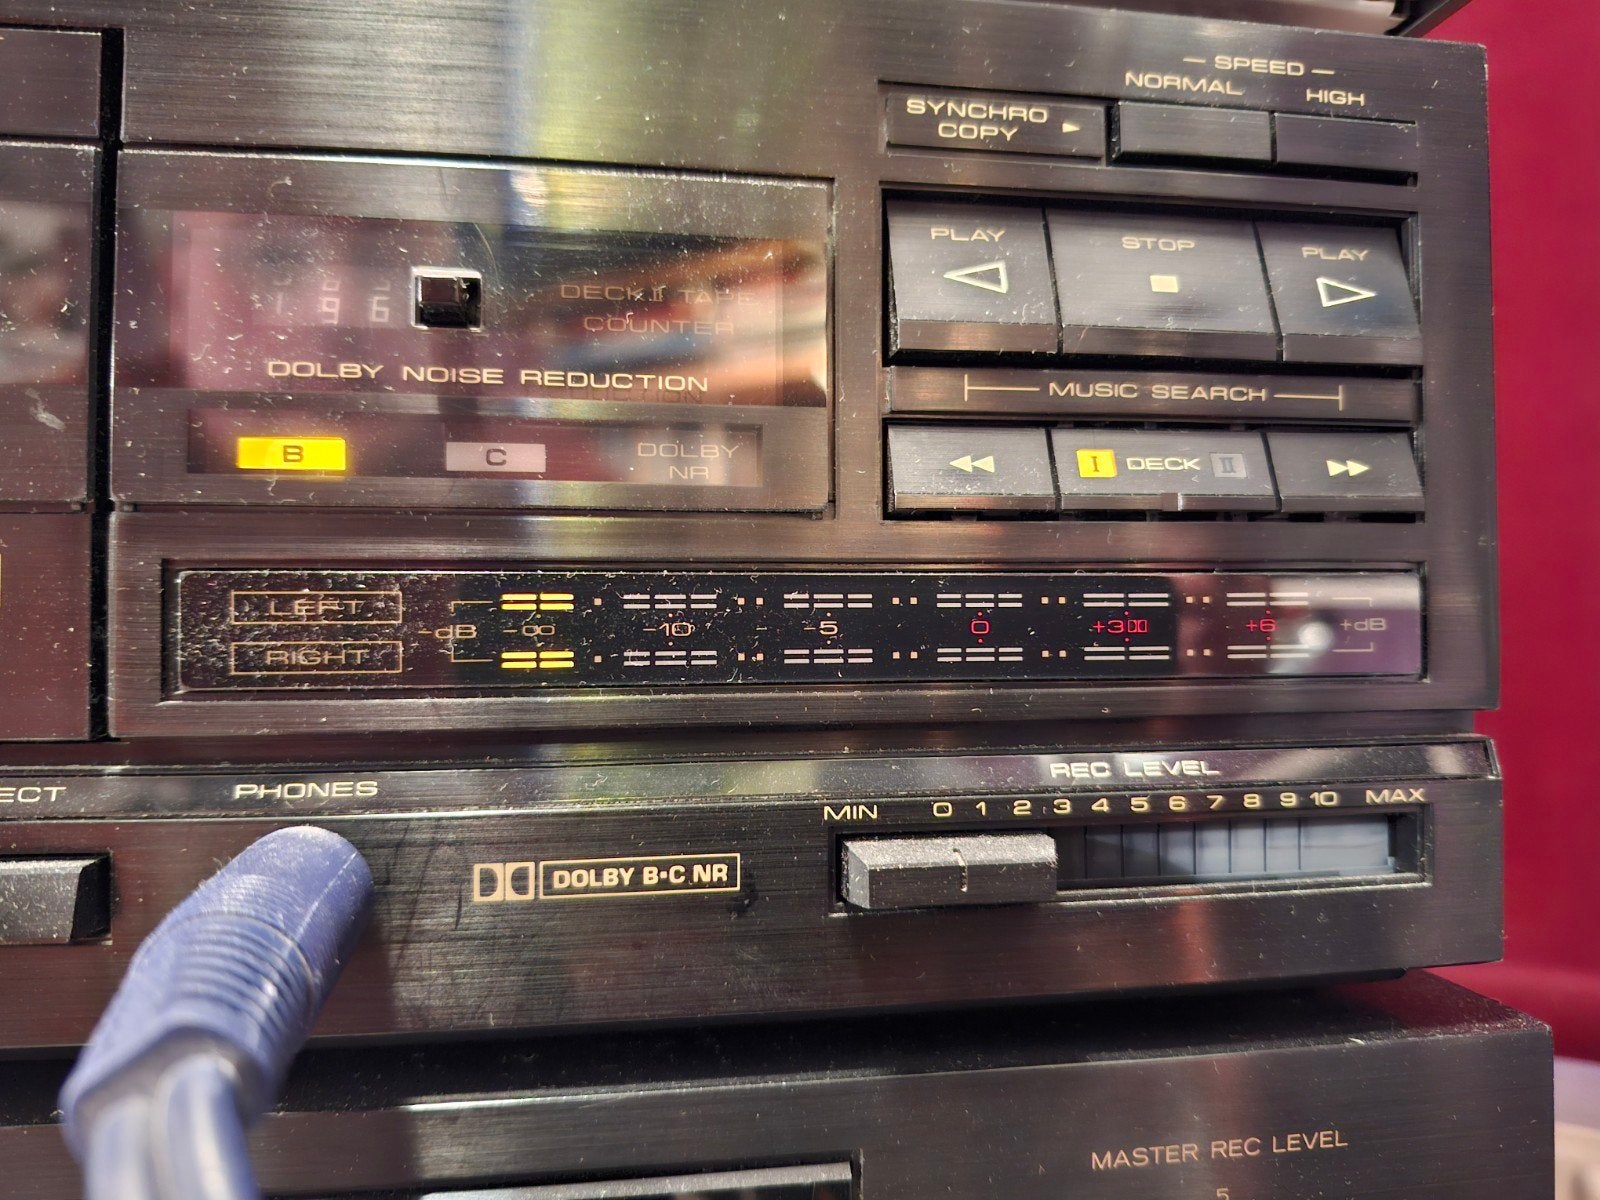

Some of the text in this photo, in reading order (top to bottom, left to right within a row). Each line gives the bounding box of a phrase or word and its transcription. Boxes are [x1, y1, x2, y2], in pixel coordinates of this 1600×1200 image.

[1213, 54, 1306, 77] SPEED
[1123, 70, 1244, 97] NORMAL
[1305, 88, 1367, 107] HIGH
[905, 97, 1050, 124] SYNCHRO
[937, 121, 1019, 142] COPY
[930, 226, 1007, 244] PLAY
[1121, 235, 1197, 253] STOP
[1301, 245, 1371, 263] PLAY
[559, 284, 644, 302] DECK
[679, 289, 757, 306] TAPE
[583, 316, 736, 336] COUNTER
[266, 359, 709, 393] DOLBY NOISE REDUCTION
[1048, 381, 1266, 402] MUSIC SEARCH
[282, 445, 305, 464] B
[485, 448, 507, 467] C
[637, 441, 739, 460] DOLBY
[668, 464, 711, 481] NR
[1126, 456, 1200, 473] DECK
[269, 598, 365, 617] LEFT
[970, 619, 991, 636] 0
[1339, 616, 1388, 632] +dB
[263, 648, 371, 667] RIGHT
[1050, 759, 1221, 780] REC LEVEL
[233, 780, 380, 800] PHONES
[823, 787, 1425, 822] MIN 0 1 2 3 4 5 6 7 8 9 10 MAX
[552, 867, 636, 890] DOLBY
[691, 862, 730, 883] NR
[1090, 1130, 1349, 1172] MASTER REC LEVEL
